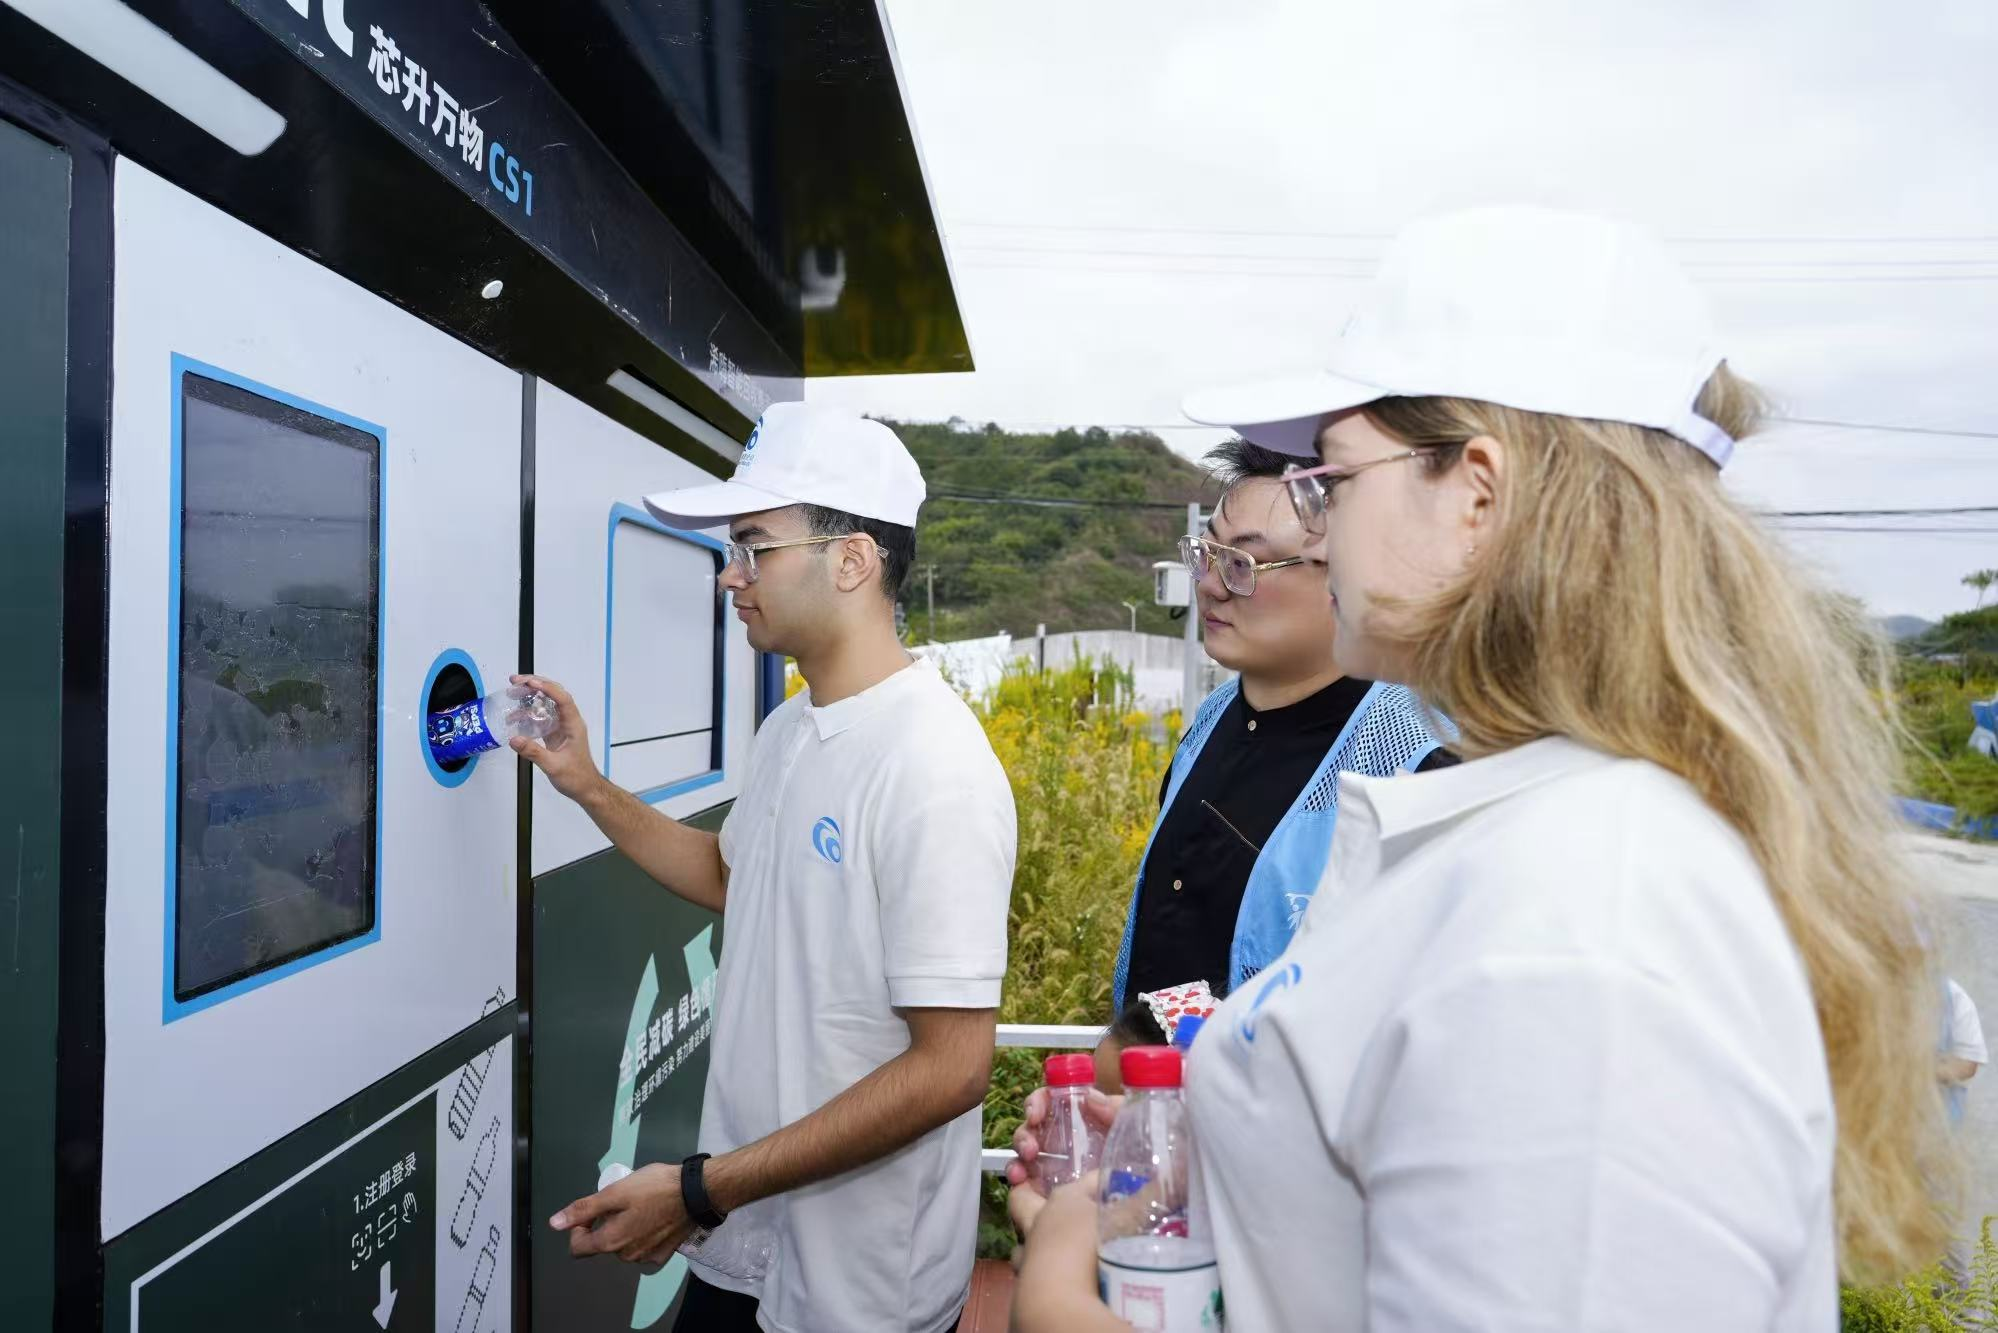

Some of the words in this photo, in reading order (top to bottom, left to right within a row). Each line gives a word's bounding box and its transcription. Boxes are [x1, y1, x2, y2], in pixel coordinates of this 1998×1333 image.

[368, 24, 484, 172] 芯升万物
[489, 142, 533, 217] CS1
[470, 704, 484, 734] PEPSI
[619, 1007, 674, 1088] 全民减碳
[353, 1152, 417, 1214] 1.注册登录
